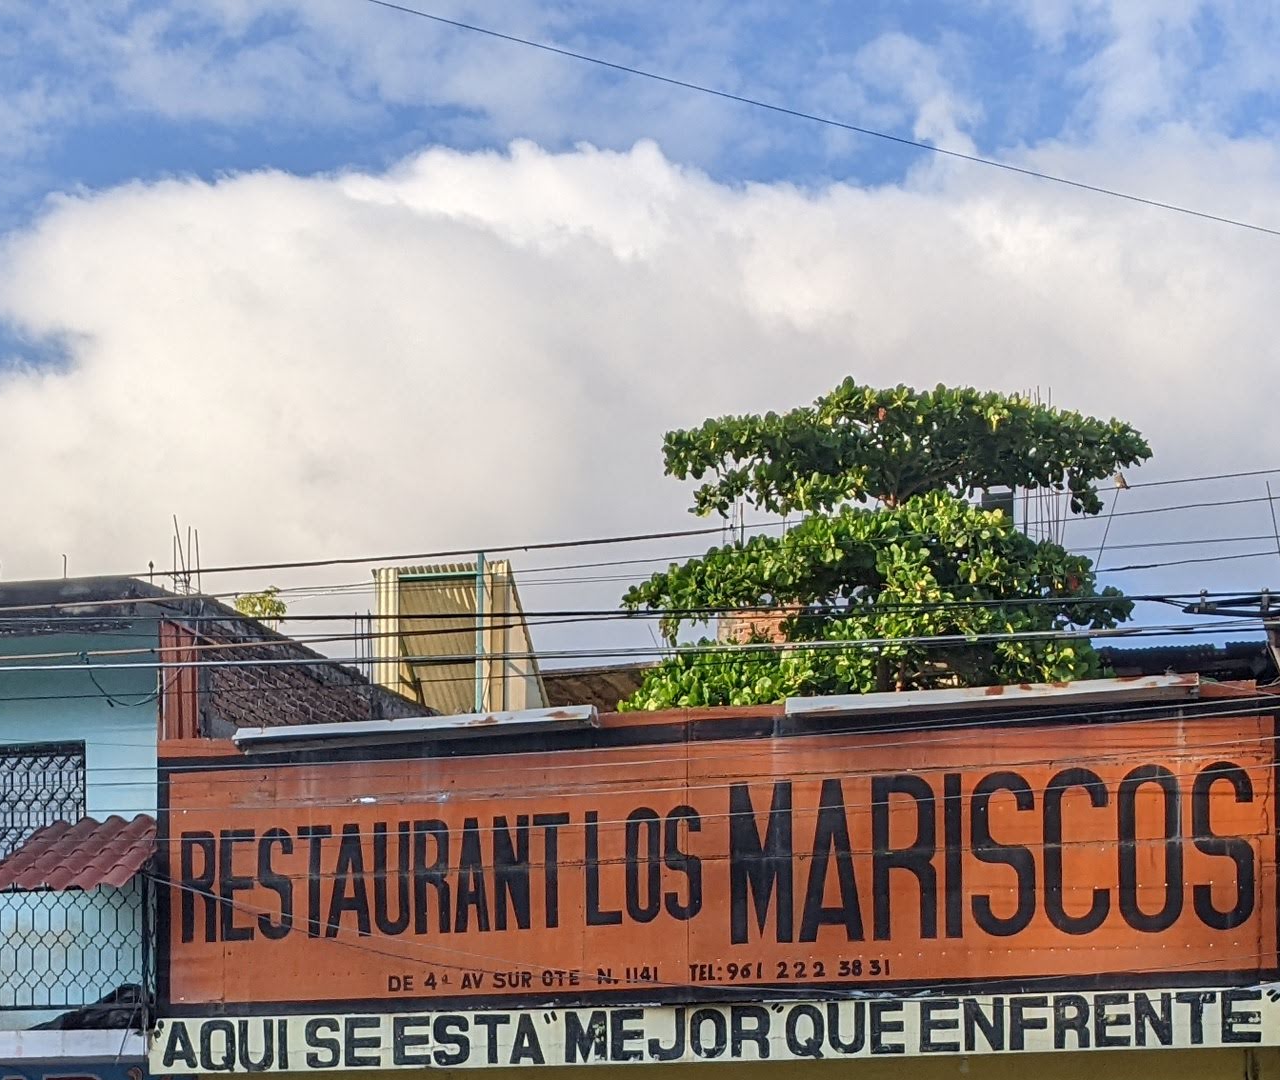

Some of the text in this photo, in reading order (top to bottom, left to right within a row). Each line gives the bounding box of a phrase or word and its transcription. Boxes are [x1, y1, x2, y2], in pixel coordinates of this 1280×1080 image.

[180, 761, 1254, 944] RESTAURANT LOS MARISCOS
[388, 975, 414, 992] DE
[461, 973, 484, 989] AV
[493, 971, 532, 989] SUR
[542, 970, 580, 986] OTE
[727, 962, 762, 980] 961
[305, 1016, 381, 1068] SE
[785, 1001, 905, 1059] QUE
